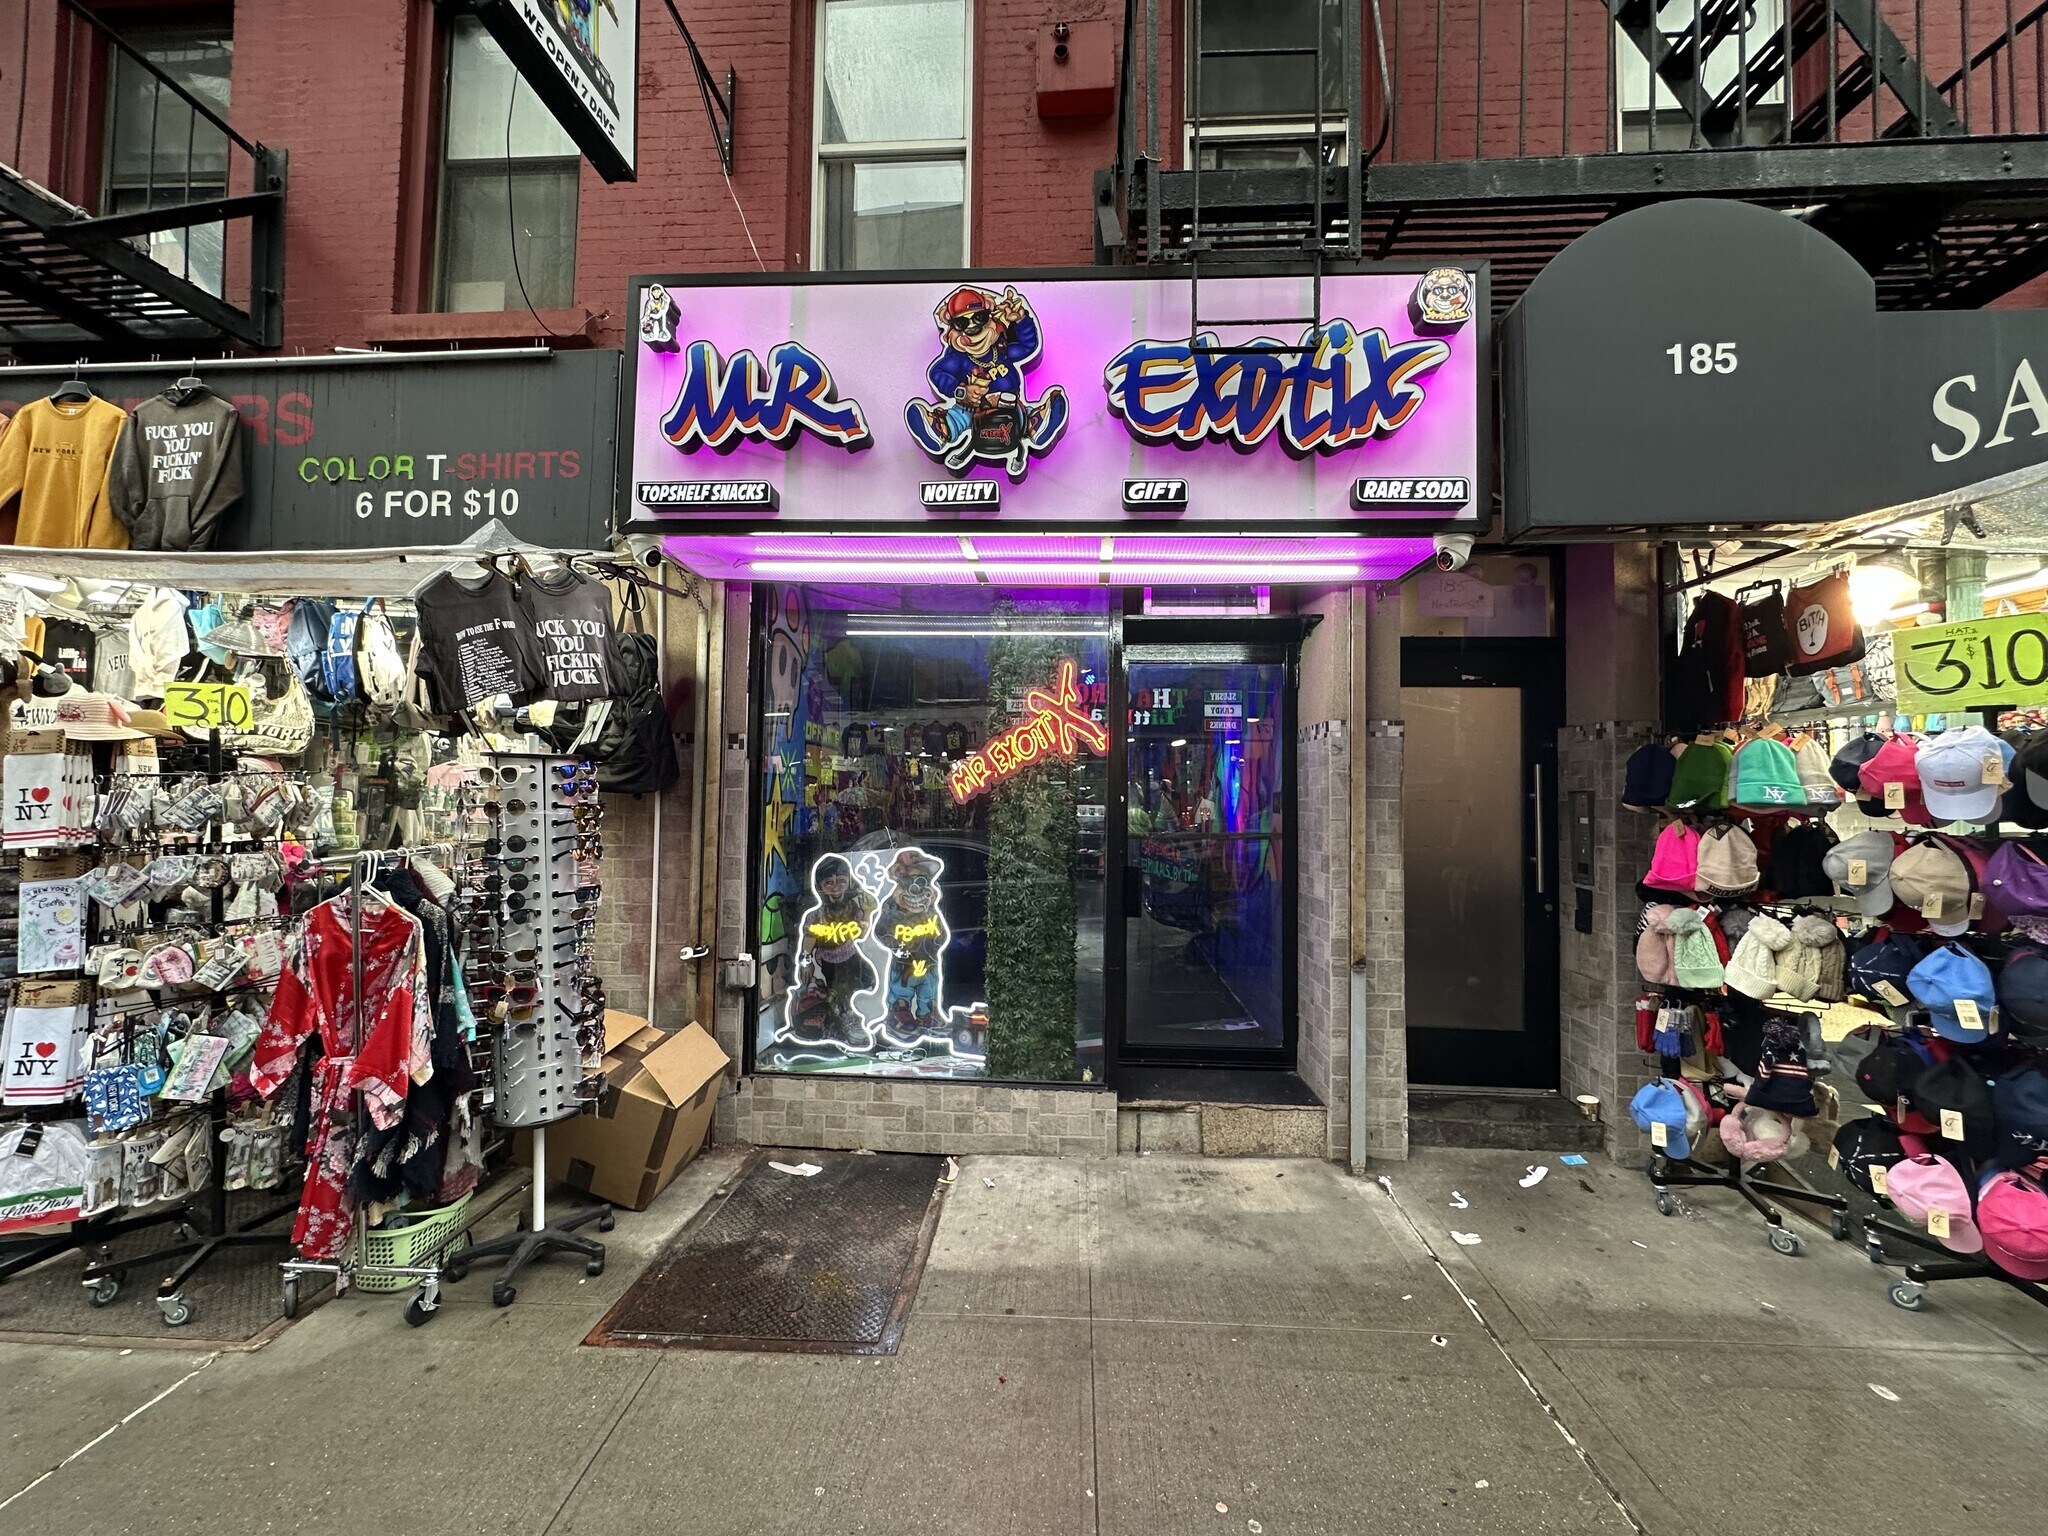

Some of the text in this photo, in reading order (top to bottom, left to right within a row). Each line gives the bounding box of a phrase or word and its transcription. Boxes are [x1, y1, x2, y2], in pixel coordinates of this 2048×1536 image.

[523, 2, 616, 138] WE OPEN 7 DAYS
[1666, 342, 1738, 375] 185
[988, 363, 1009, 381] PB
[662, 343, 866, 444] MR
[1931, 358, 2048, 463] SA
[144, 421, 214, 441] FUCK YOU
[163, 438, 191, 455] YOU
[152, 451, 203, 470] FUCKIN'
[298, 450, 581, 484] COLOR T-SHIRTS
[157, 466, 194, 484] FUCK
[641, 482, 765, 502] TOPSHELF SNACKS
[923, 482, 995, 502] NOVELTY
[1127, 481, 1182, 501] GIFT
[1362, 480, 1465, 499] RARE SODA
[355, 487, 520, 520] 6 FOR $10
[536, 618, 606, 638] UCK YOU
[1798, 610, 1826, 632] BITCH
[551, 636, 585, 653] YOU
[1904, 639, 1971, 696] 3
[166, 687, 209, 720] 3
[257, 724, 304, 741] YORK
[137, 764, 153, 774] NEW
[952, 756, 992, 799] MR
[18, 788, 30, 804] I
[1763, 785, 1789, 803] NY
[1808, 786, 1835, 803] NY
[14, 803, 53, 821] NY
[33, 886, 48, 895] NEW
[20, 1042, 34, 1058] I
[12, 1060, 59, 1076] NY
[108, 1084, 120, 1113] NEW YORK
[130, 1144, 154, 1155] NEW
[1, 1196, 74, 1221] Little Italy
